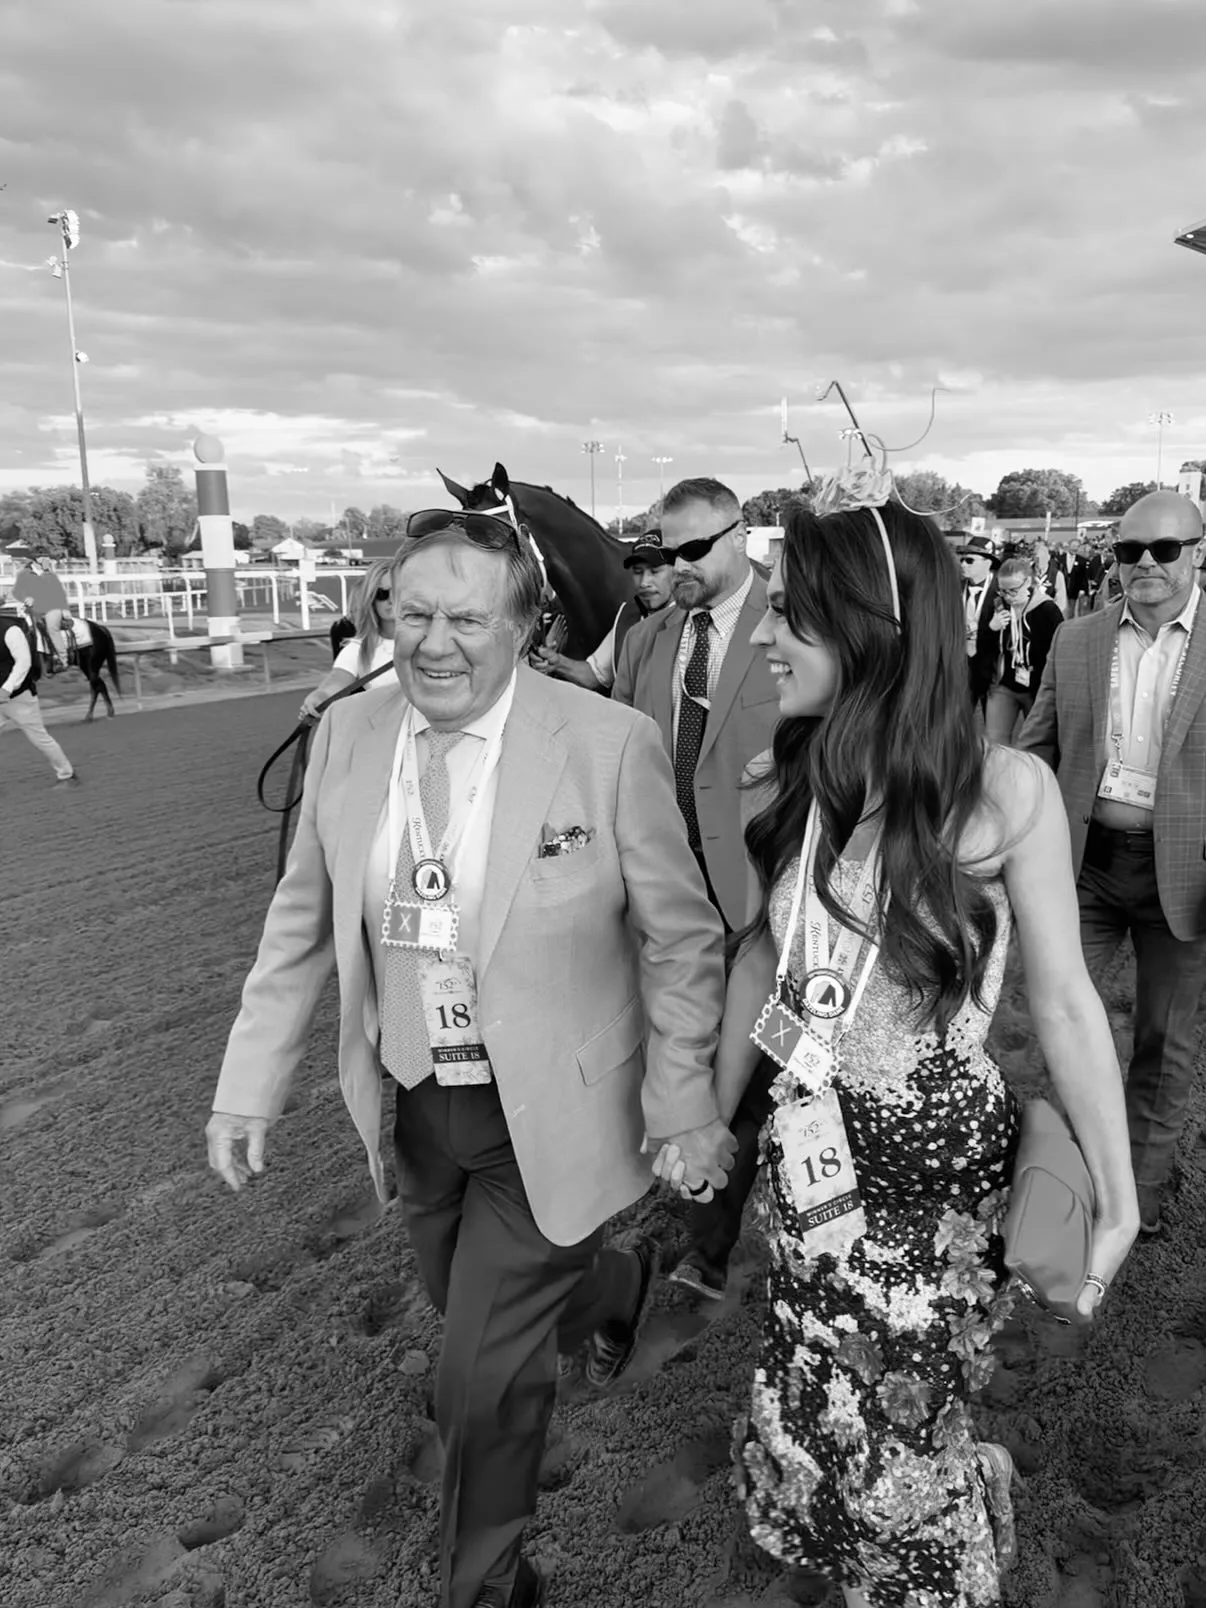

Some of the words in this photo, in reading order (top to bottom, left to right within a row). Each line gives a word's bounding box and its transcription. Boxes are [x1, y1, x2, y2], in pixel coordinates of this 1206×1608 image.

[436, 1003, 471, 1029] 18
[439, 1052, 468, 1062] SUITE
[470, 1051, 481, 1060] 18
[801, 1147, 842, 1187] 18
[808, 1206, 841, 1228] SUITE
[843, 1201, 854, 1213] 18
